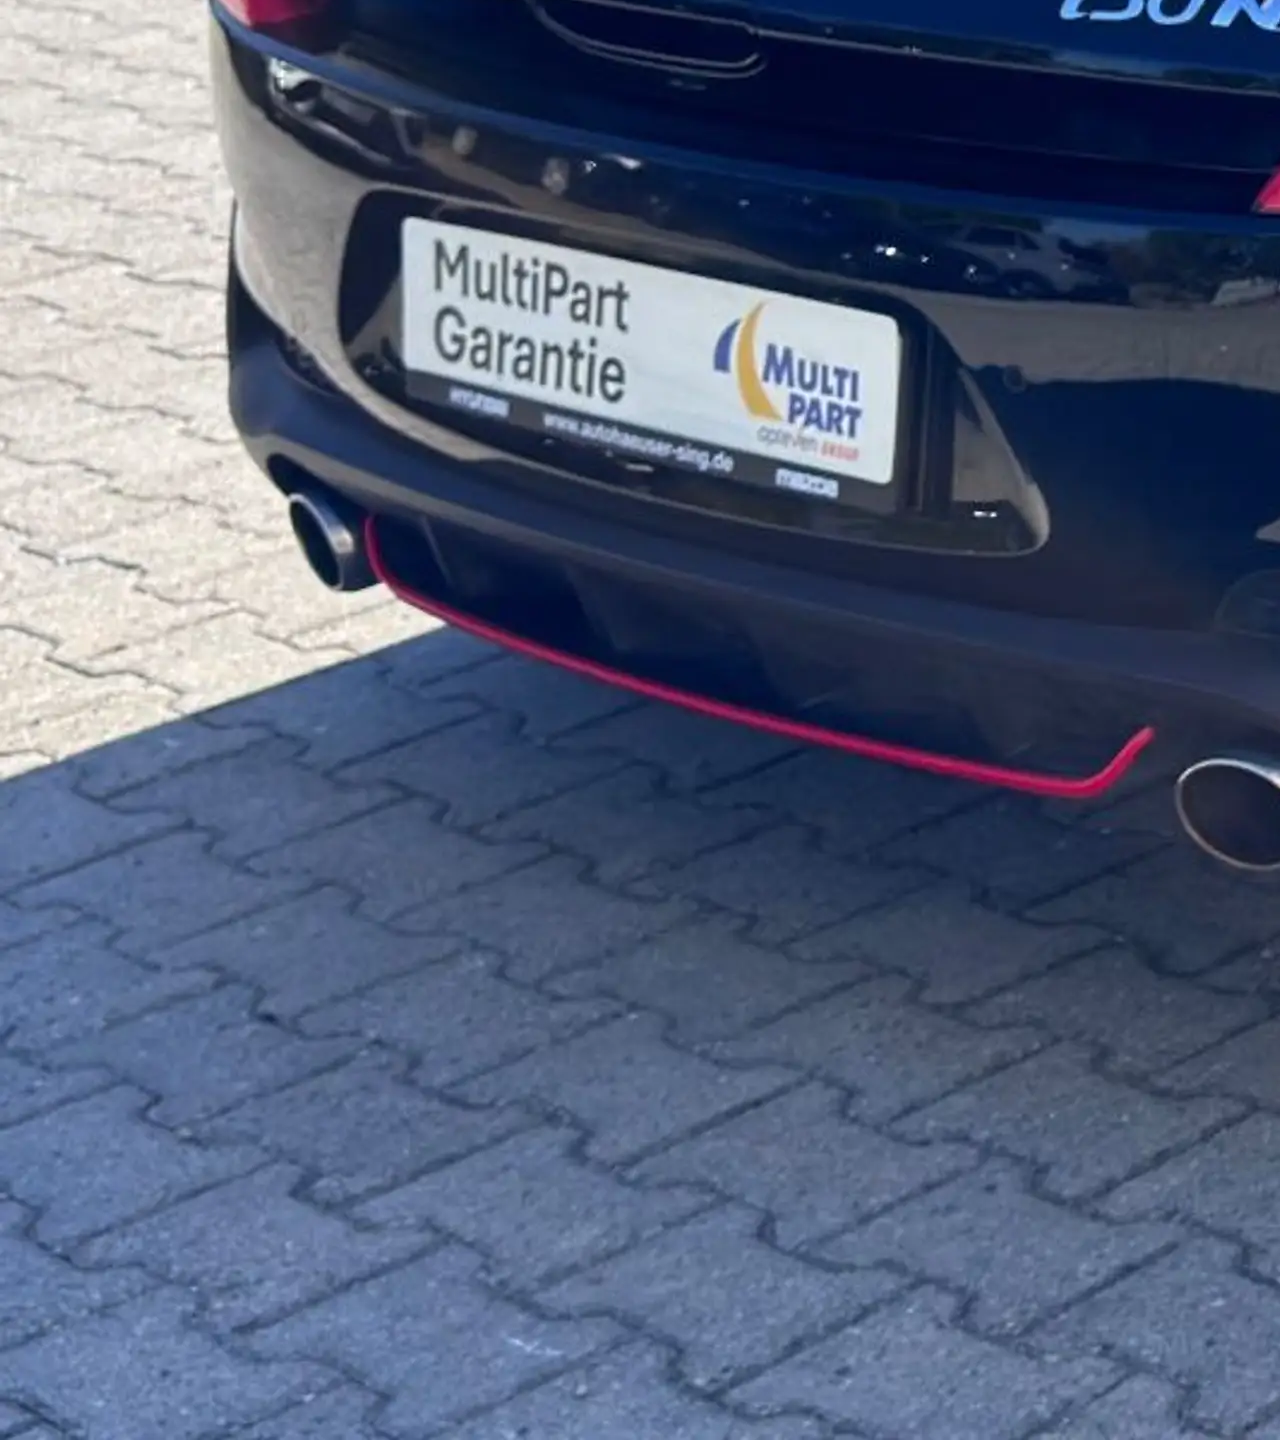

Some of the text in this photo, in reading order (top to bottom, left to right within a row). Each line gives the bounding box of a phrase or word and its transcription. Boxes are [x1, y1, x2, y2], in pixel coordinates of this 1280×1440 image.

[432, 239, 631, 334] MultiPart
[432, 305, 628, 404] Garantie
[787, 391, 864, 440] PART
